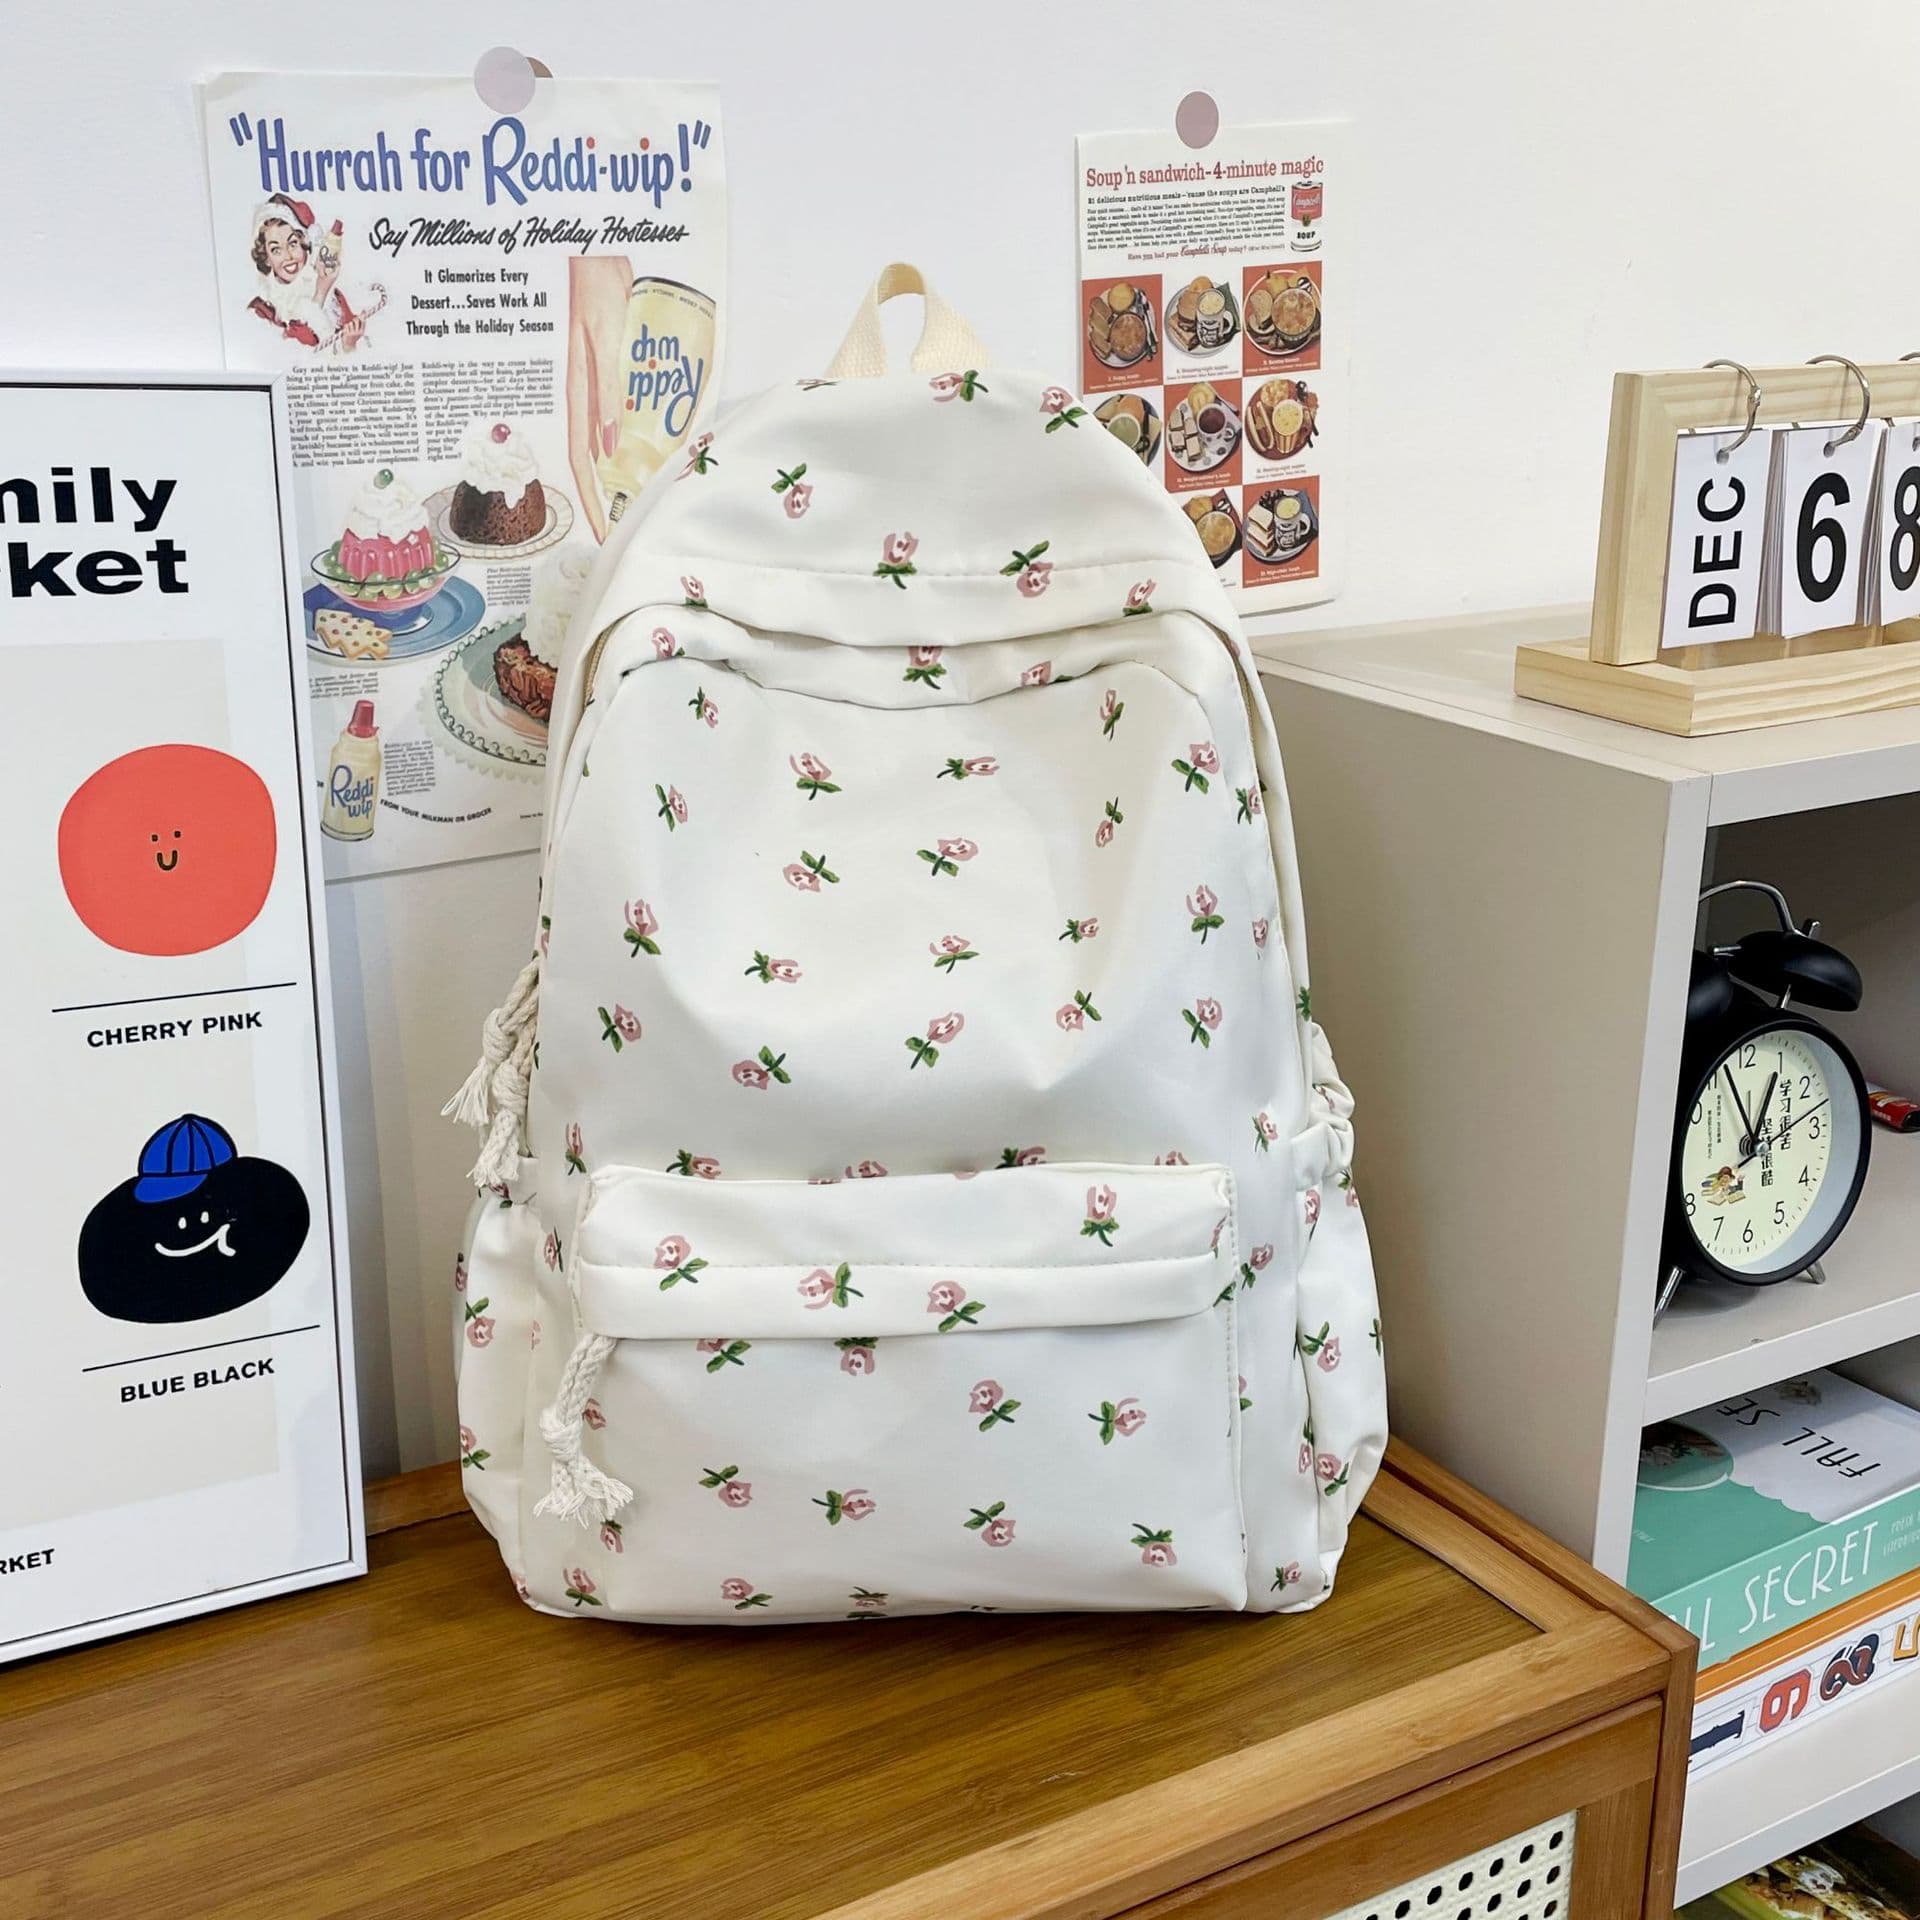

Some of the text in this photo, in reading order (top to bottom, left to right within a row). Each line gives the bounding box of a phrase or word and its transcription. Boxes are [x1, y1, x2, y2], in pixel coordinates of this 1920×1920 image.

[229, 112, 711, 208] "Hurrah for Reddi-wip!"
[1086, 168, 1122, 190] Soup
[1281, 156, 1324, 178] magic
[369, 216, 689, 253] Say Millions of Holiday Hostesses
[424, 268, 528, 287] It Glamorizes Every
[499, 292, 529, 308] Work
[533, 292, 547, 307] All
[406, 317, 554, 338] Through the Holiday Season
[631, 324, 680, 369] wip
[626, 355, 704, 437] Reddi
[1796, 465, 1920, 602] 6 8
[1688, 476, 1746, 628] DEC
[0, 539, 189, 597] ket
[330, 765, 375, 809] Reddi
[347, 798, 374, 819] wip
[380, 799, 399, 811] FROM
[401, 806, 419, 817] YOUR
[467, 807, 492, 821] GROCER
[86, 1011, 264, 1048] CHERRY PINK
[1737, 1044, 1756, 1069] 12
[1778, 1051, 1783, 1073] 1
[1799, 1075, 1810, 1099] 2
[1691, 1100, 1702, 1125] 0
[1809, 1116, 1820, 1139] 3
[1798, 1165, 1810, 1187] 4
[1773, 1201, 1785, 1225] 5
[1713, 1216, 1724, 1241] 7
[1742, 1219, 1754, 1243] 6
[120, 1357, 276, 1403] BLUE BLACK
[1782, 1427, 1881, 1478] FALL
[1739, 1521, 1878, 1634] SECRET
